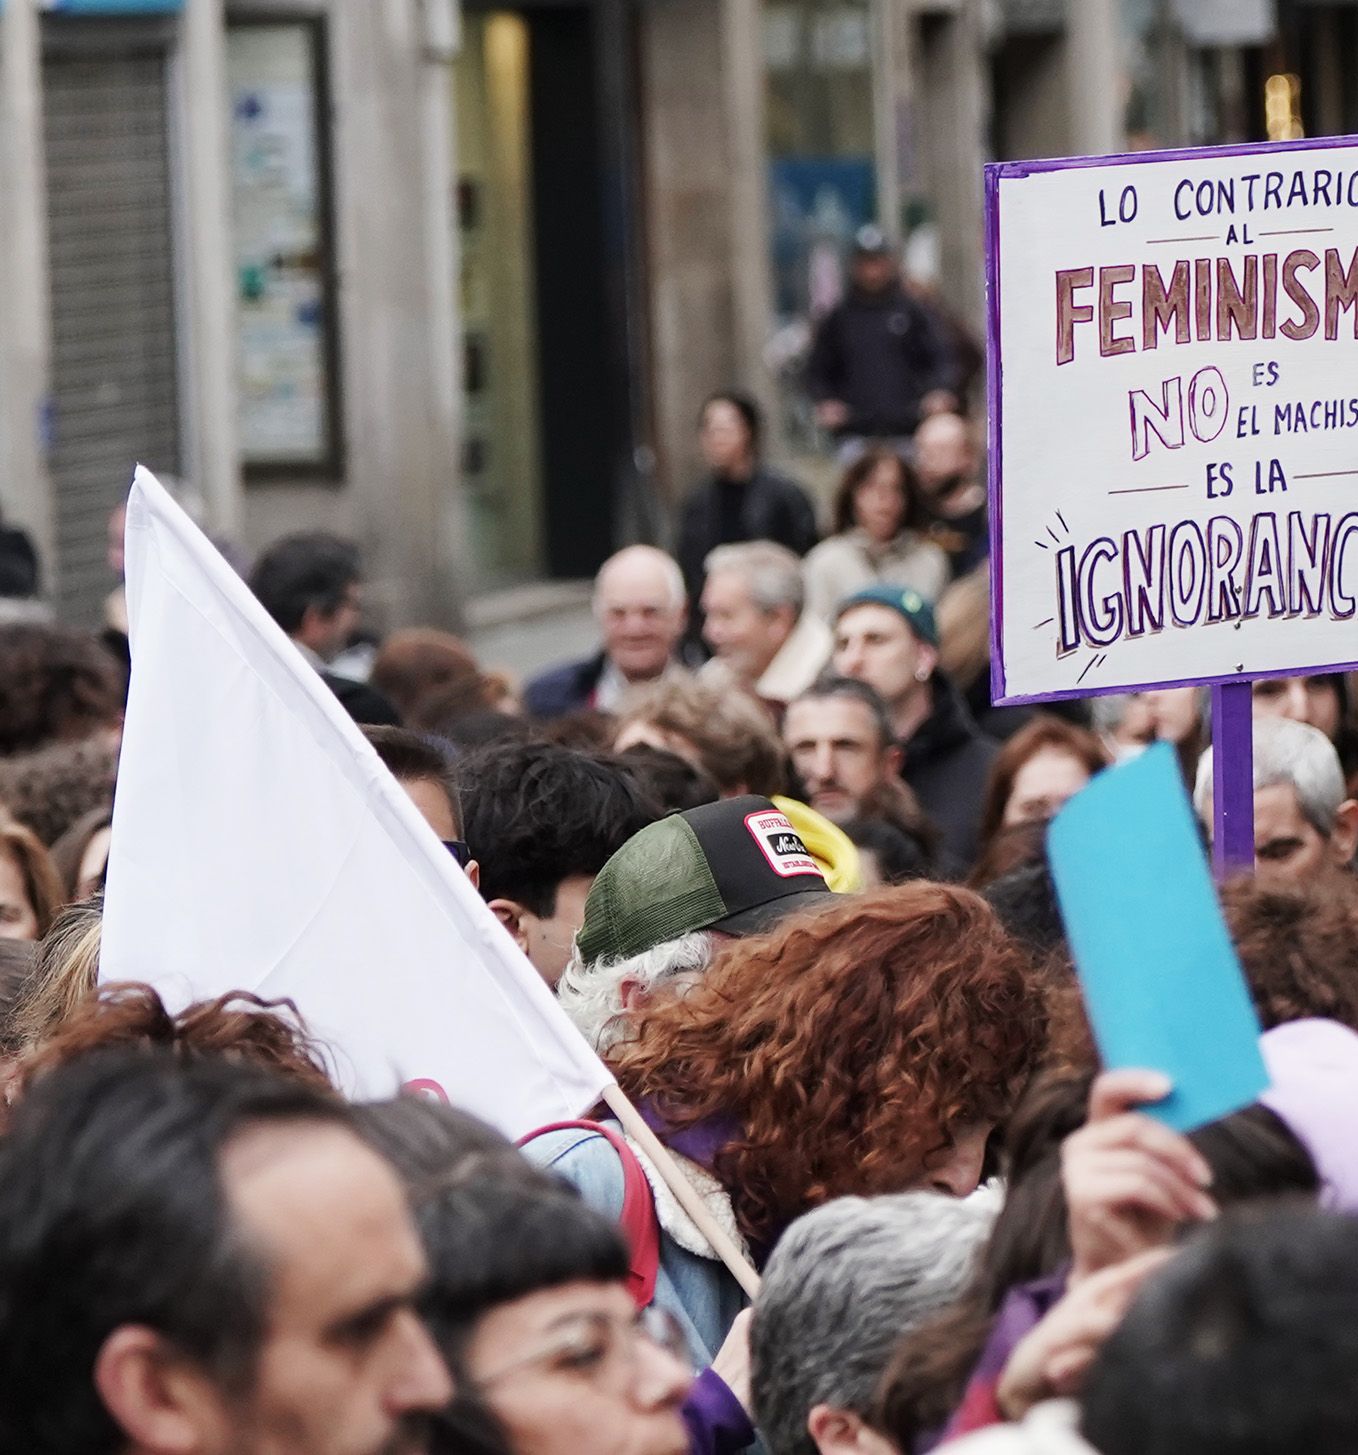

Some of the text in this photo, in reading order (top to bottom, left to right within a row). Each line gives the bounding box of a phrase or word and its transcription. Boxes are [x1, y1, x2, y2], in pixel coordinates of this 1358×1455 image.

[1098, 184, 1139, 228] LO
[1225, 223, 1255, 246] AL
[1252, 361, 1281, 387] ES
[1128, 365, 1230, 462] NO
[1236, 406, 1262, 439] EL
[1206, 458, 1289, 499] ES LA
